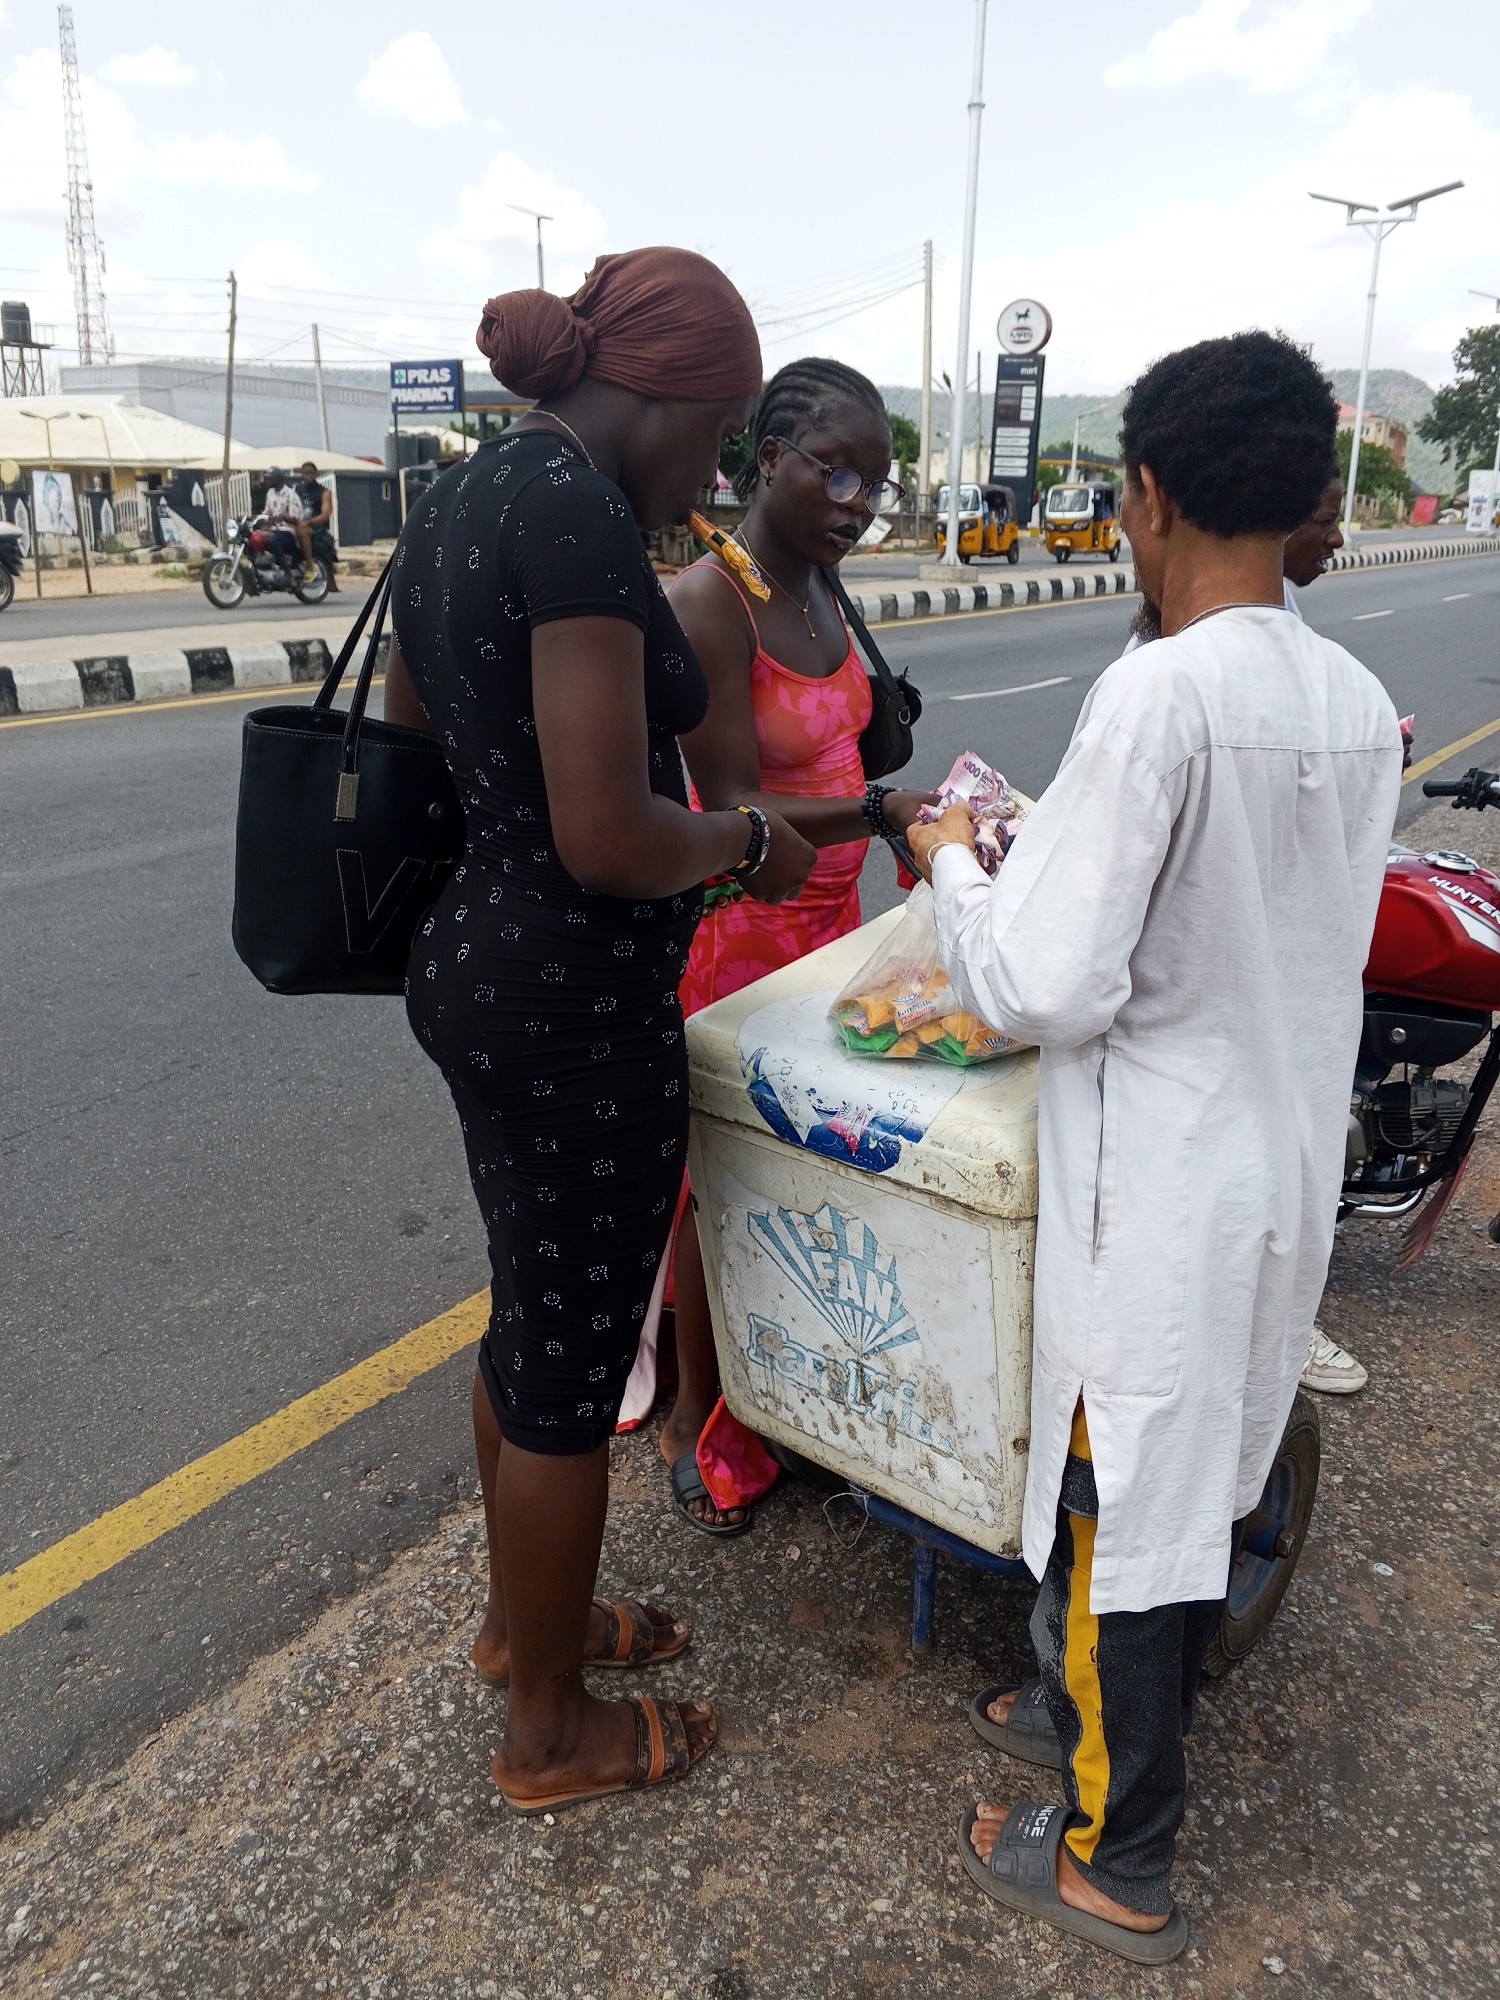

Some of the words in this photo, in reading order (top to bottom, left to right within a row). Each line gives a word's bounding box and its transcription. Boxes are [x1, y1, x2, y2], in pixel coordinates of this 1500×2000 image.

[407, 367, 452, 384] PRAS
[391, 386, 455, 402] PHARMACY
[1427, 875, 1500, 925] HUNTER
